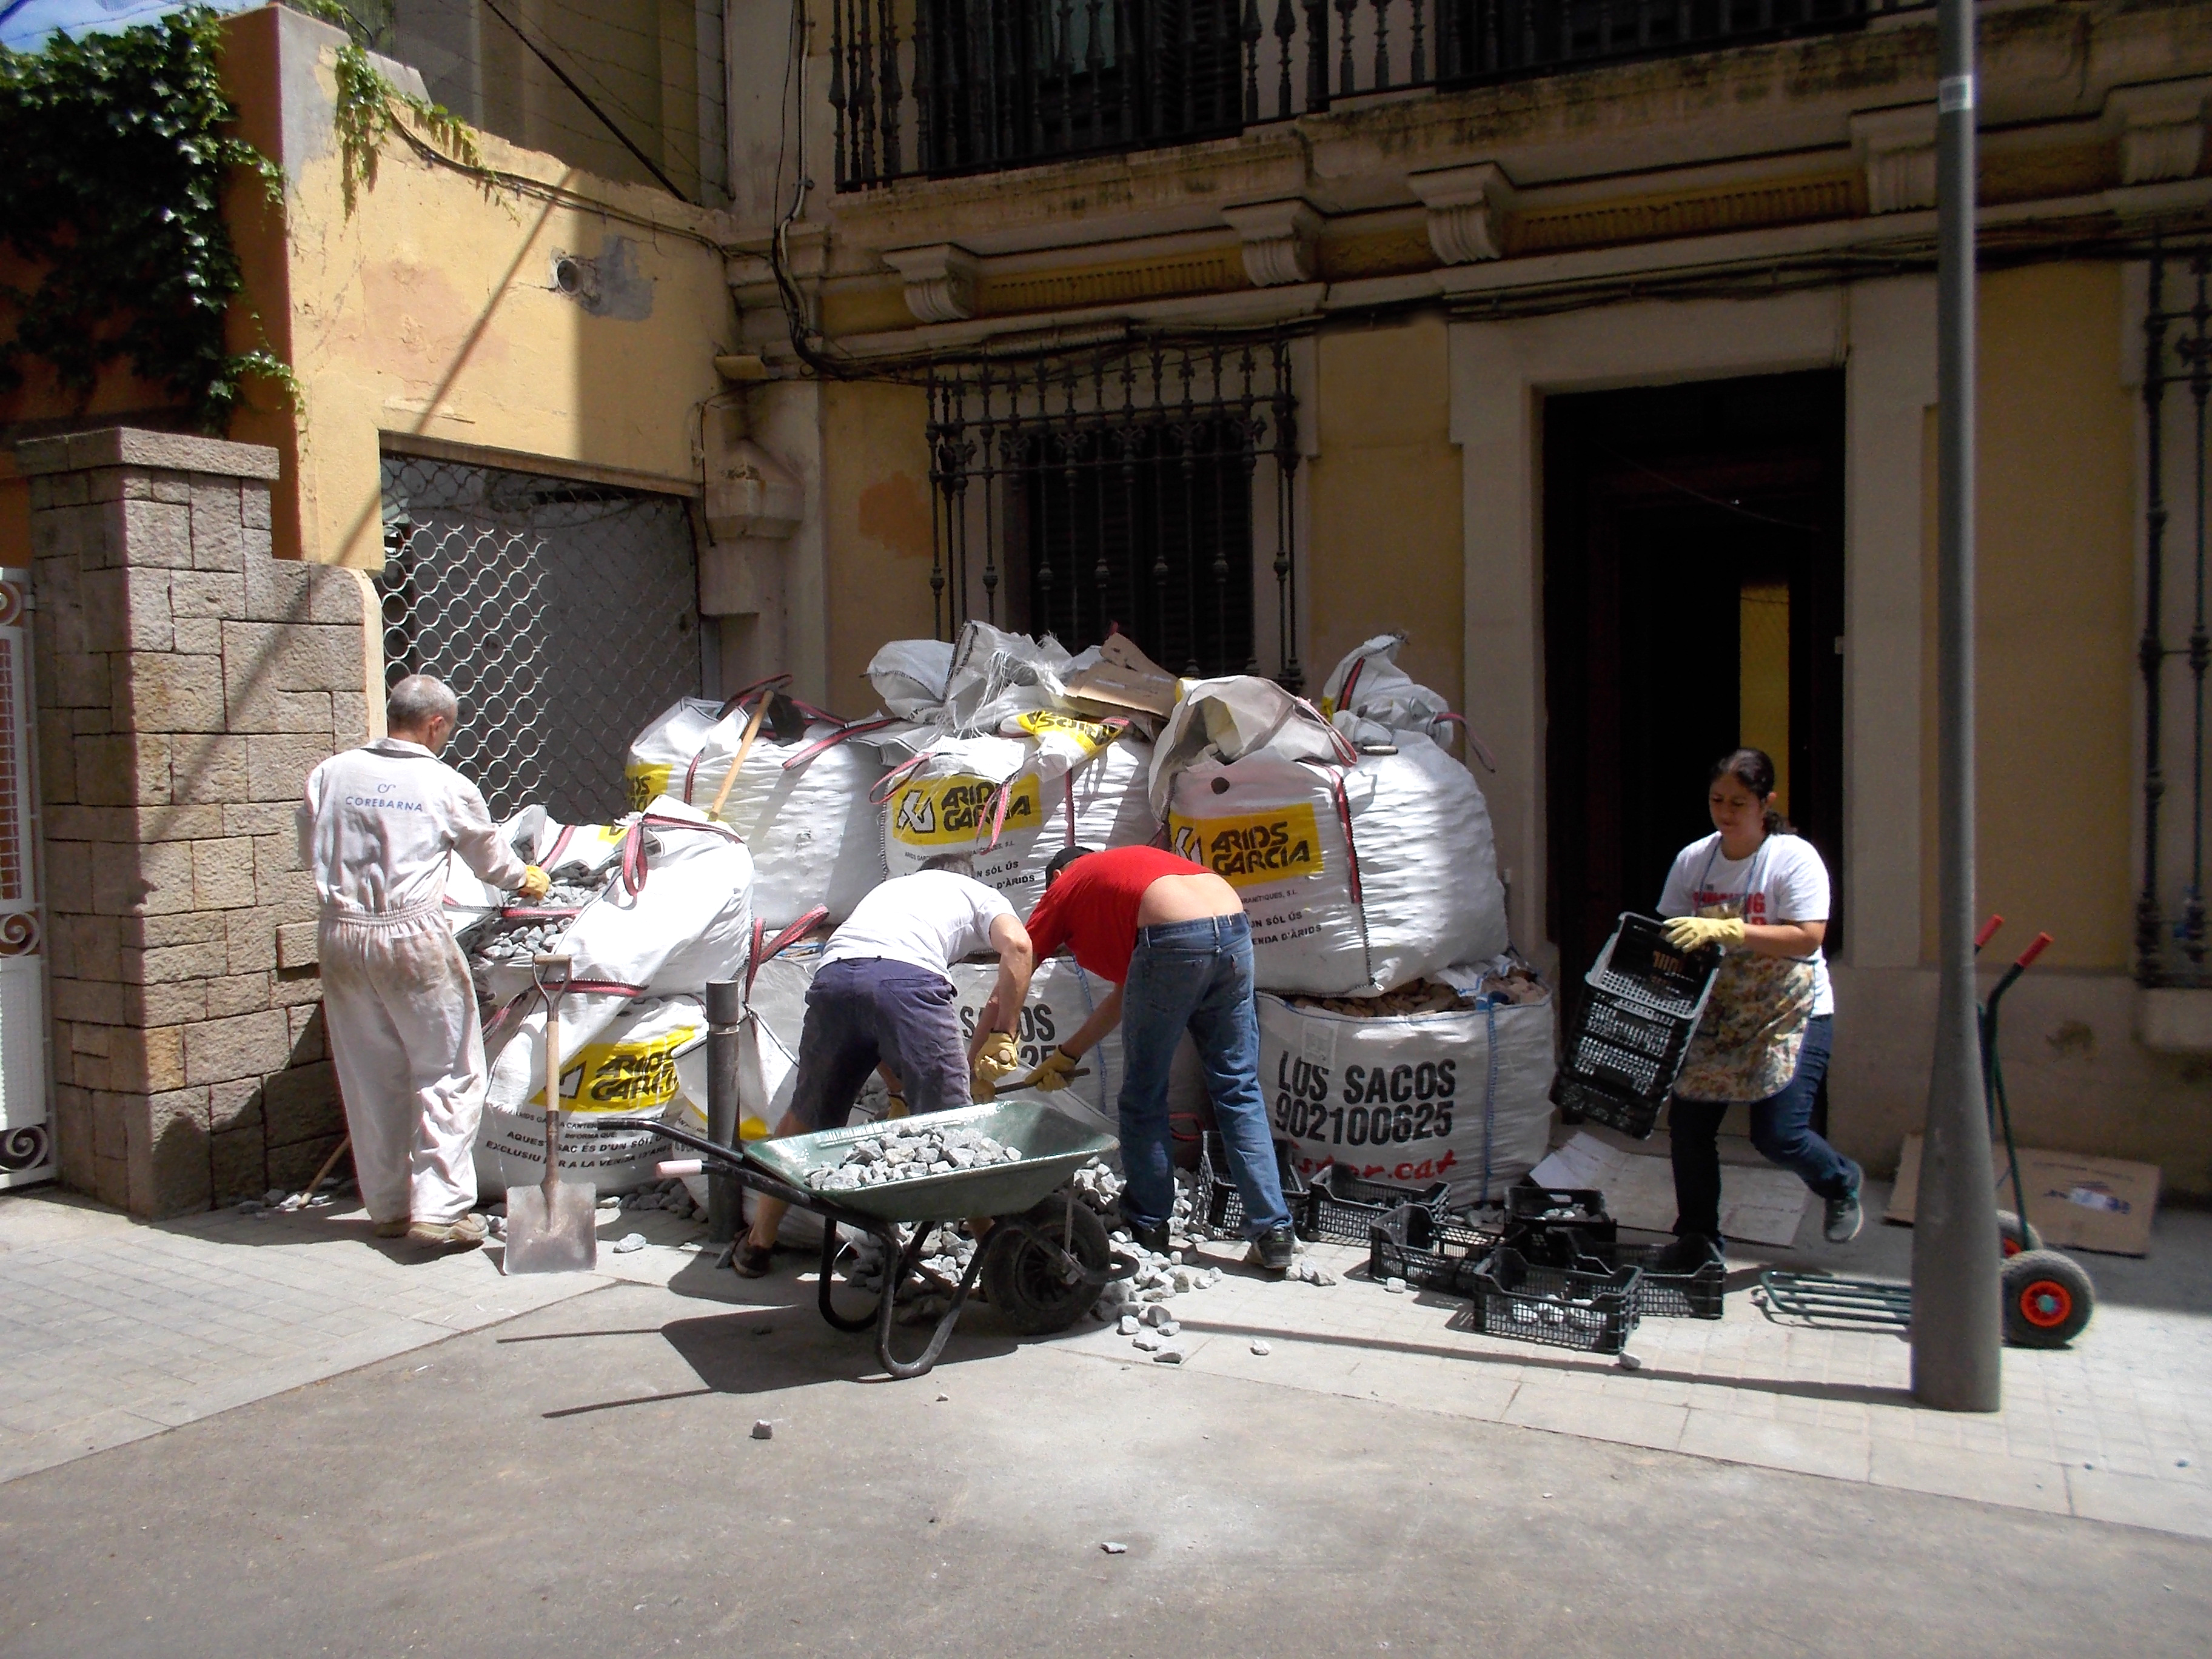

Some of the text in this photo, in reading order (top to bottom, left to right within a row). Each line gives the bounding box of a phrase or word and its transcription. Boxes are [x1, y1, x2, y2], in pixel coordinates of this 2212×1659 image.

[345, 796, 423, 812] COREBARNA
[941, 782, 1011, 811] ARID
[1211, 821, 1289, 853] ARIDS
[985, 864, 1003, 877] SÓL
[1005, 860, 1019, 870] ÚS
[1212, 840, 1310, 876] GARCIA
[996, 874, 1035, 890] D'ÀRIDS
[1265, 915, 1286, 926] SÓL
[1289, 911, 1303, 921] ÚS
[1252, 924, 1322, 945] ENDA D'ÀRIDS
[591, 1062, 680, 1101] GARCI
[1278, 1050, 1456, 1105] LOS SACOS
[1275, 1092, 1454, 1146] 902100625
[486, 1140, 541, 1162] EXCLUSIU
[507, 1131, 547, 1147] AQUES
[600, 1143, 627, 1151] D'UN
